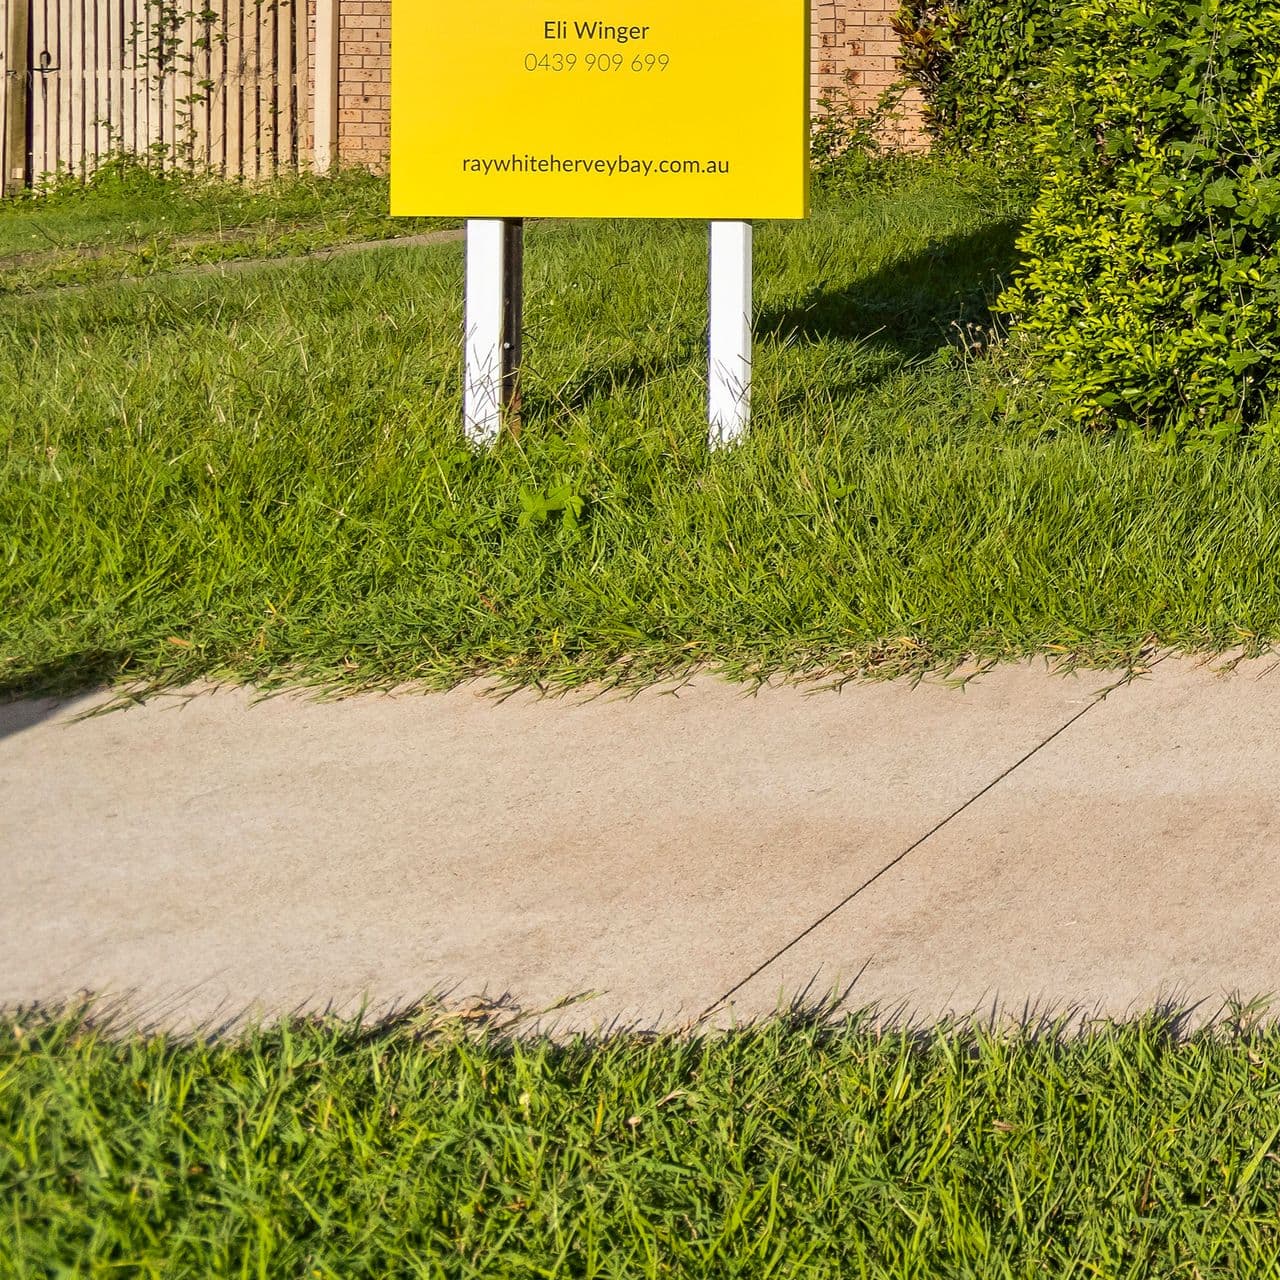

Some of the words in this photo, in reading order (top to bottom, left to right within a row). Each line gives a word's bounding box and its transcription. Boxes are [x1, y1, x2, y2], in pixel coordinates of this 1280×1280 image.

[543, 20, 568, 41] Eli
[573, 20, 650, 44] Winger
[524, 52, 577, 72] 0439
[584, 52, 623, 72] 909
[630, 52, 669, 72] 699
[462, 152, 729, 177] raywhiteherveybay.com.au
